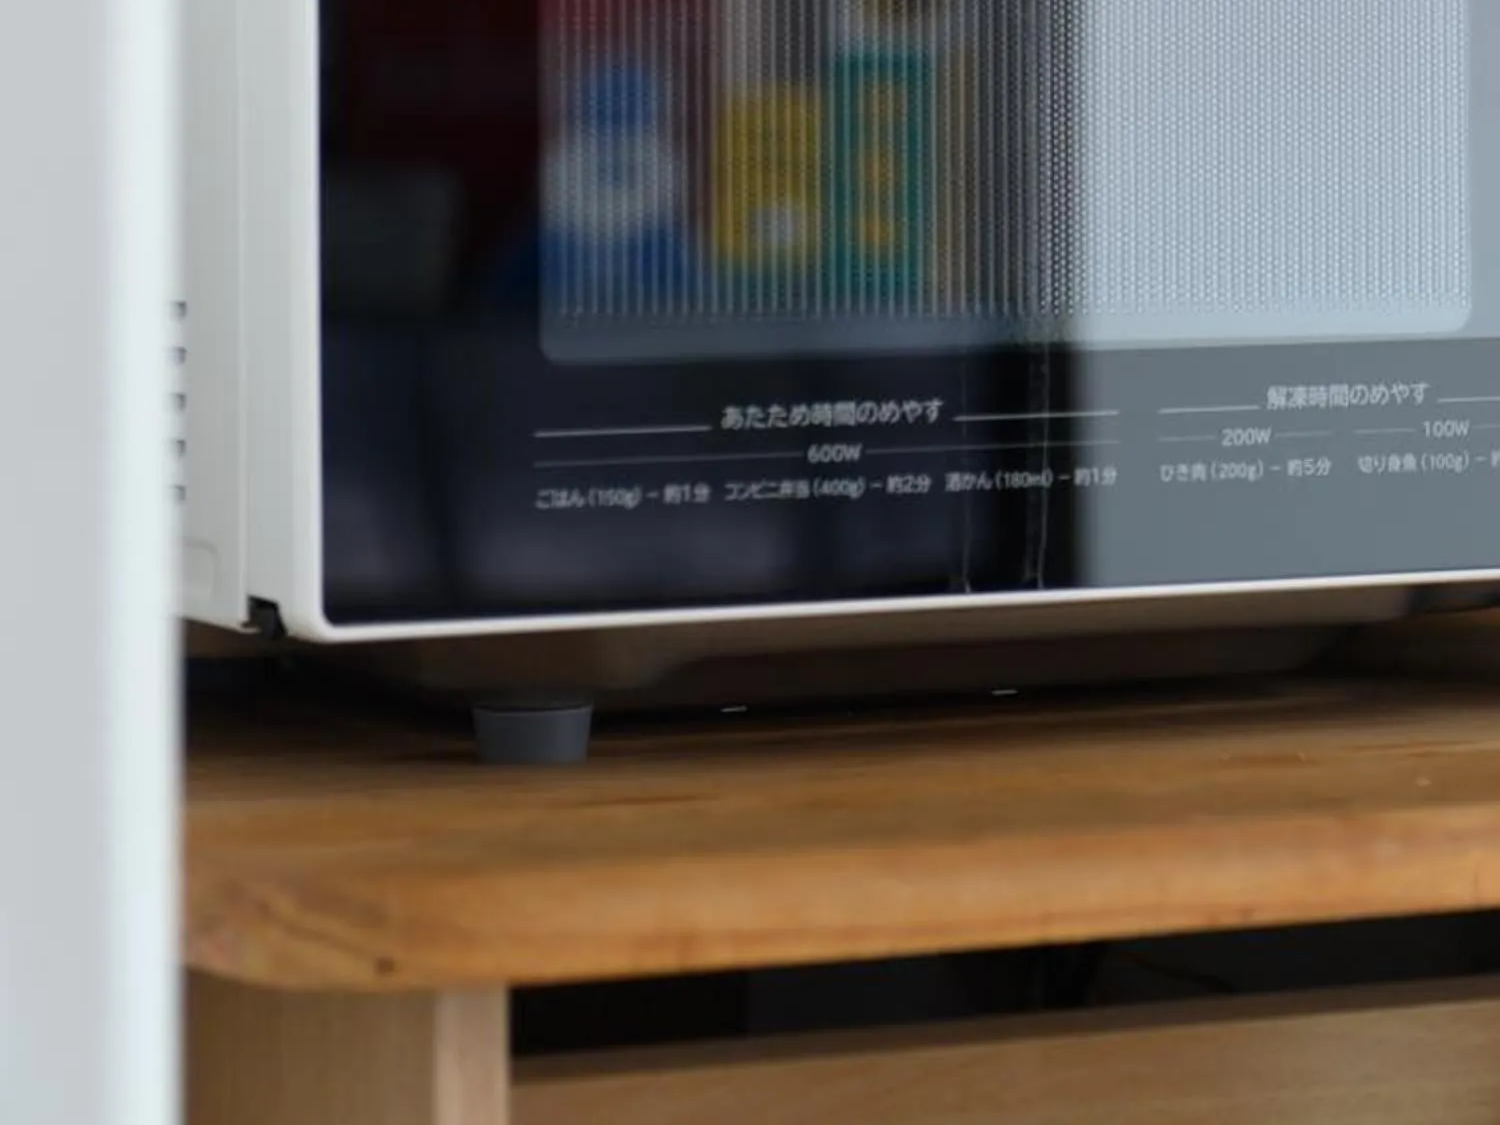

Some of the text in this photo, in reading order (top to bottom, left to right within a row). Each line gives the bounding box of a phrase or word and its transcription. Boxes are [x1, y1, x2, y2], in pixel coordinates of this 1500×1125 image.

[1267, 381, 1430, 410] 解凍時間のめやす
[720, 399, 943, 429] あたため時間のめやす
[1222, 428, 1271, 447] 200W
[1423, 420, 1469, 438] 100W
[807, 443, 862, 463] 600W
